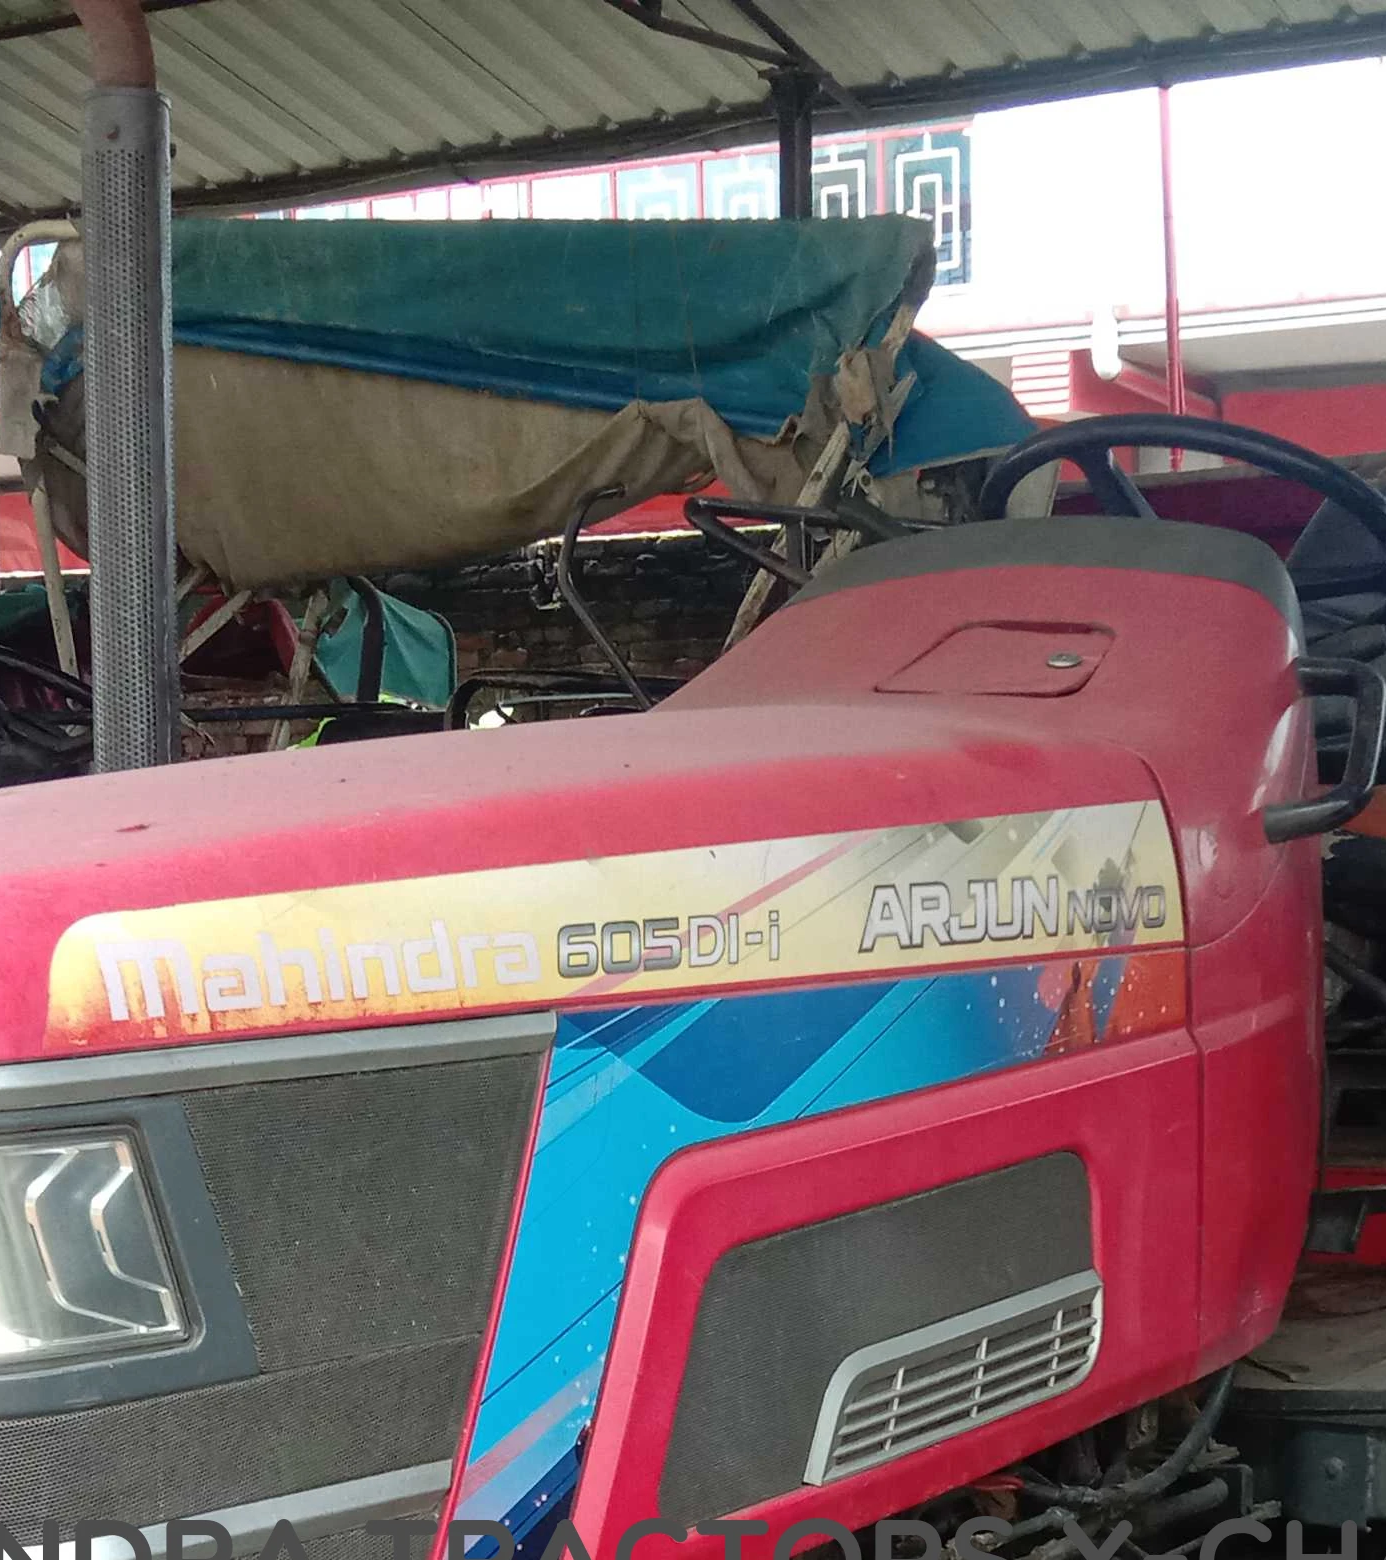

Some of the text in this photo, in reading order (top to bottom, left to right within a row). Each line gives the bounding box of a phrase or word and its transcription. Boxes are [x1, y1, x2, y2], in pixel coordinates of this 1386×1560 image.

[95, 919, 542, 1022] Mahindra
[858, 875, 1060, 953] ARJUN
[1065, 883, 1167, 936] NOVO
